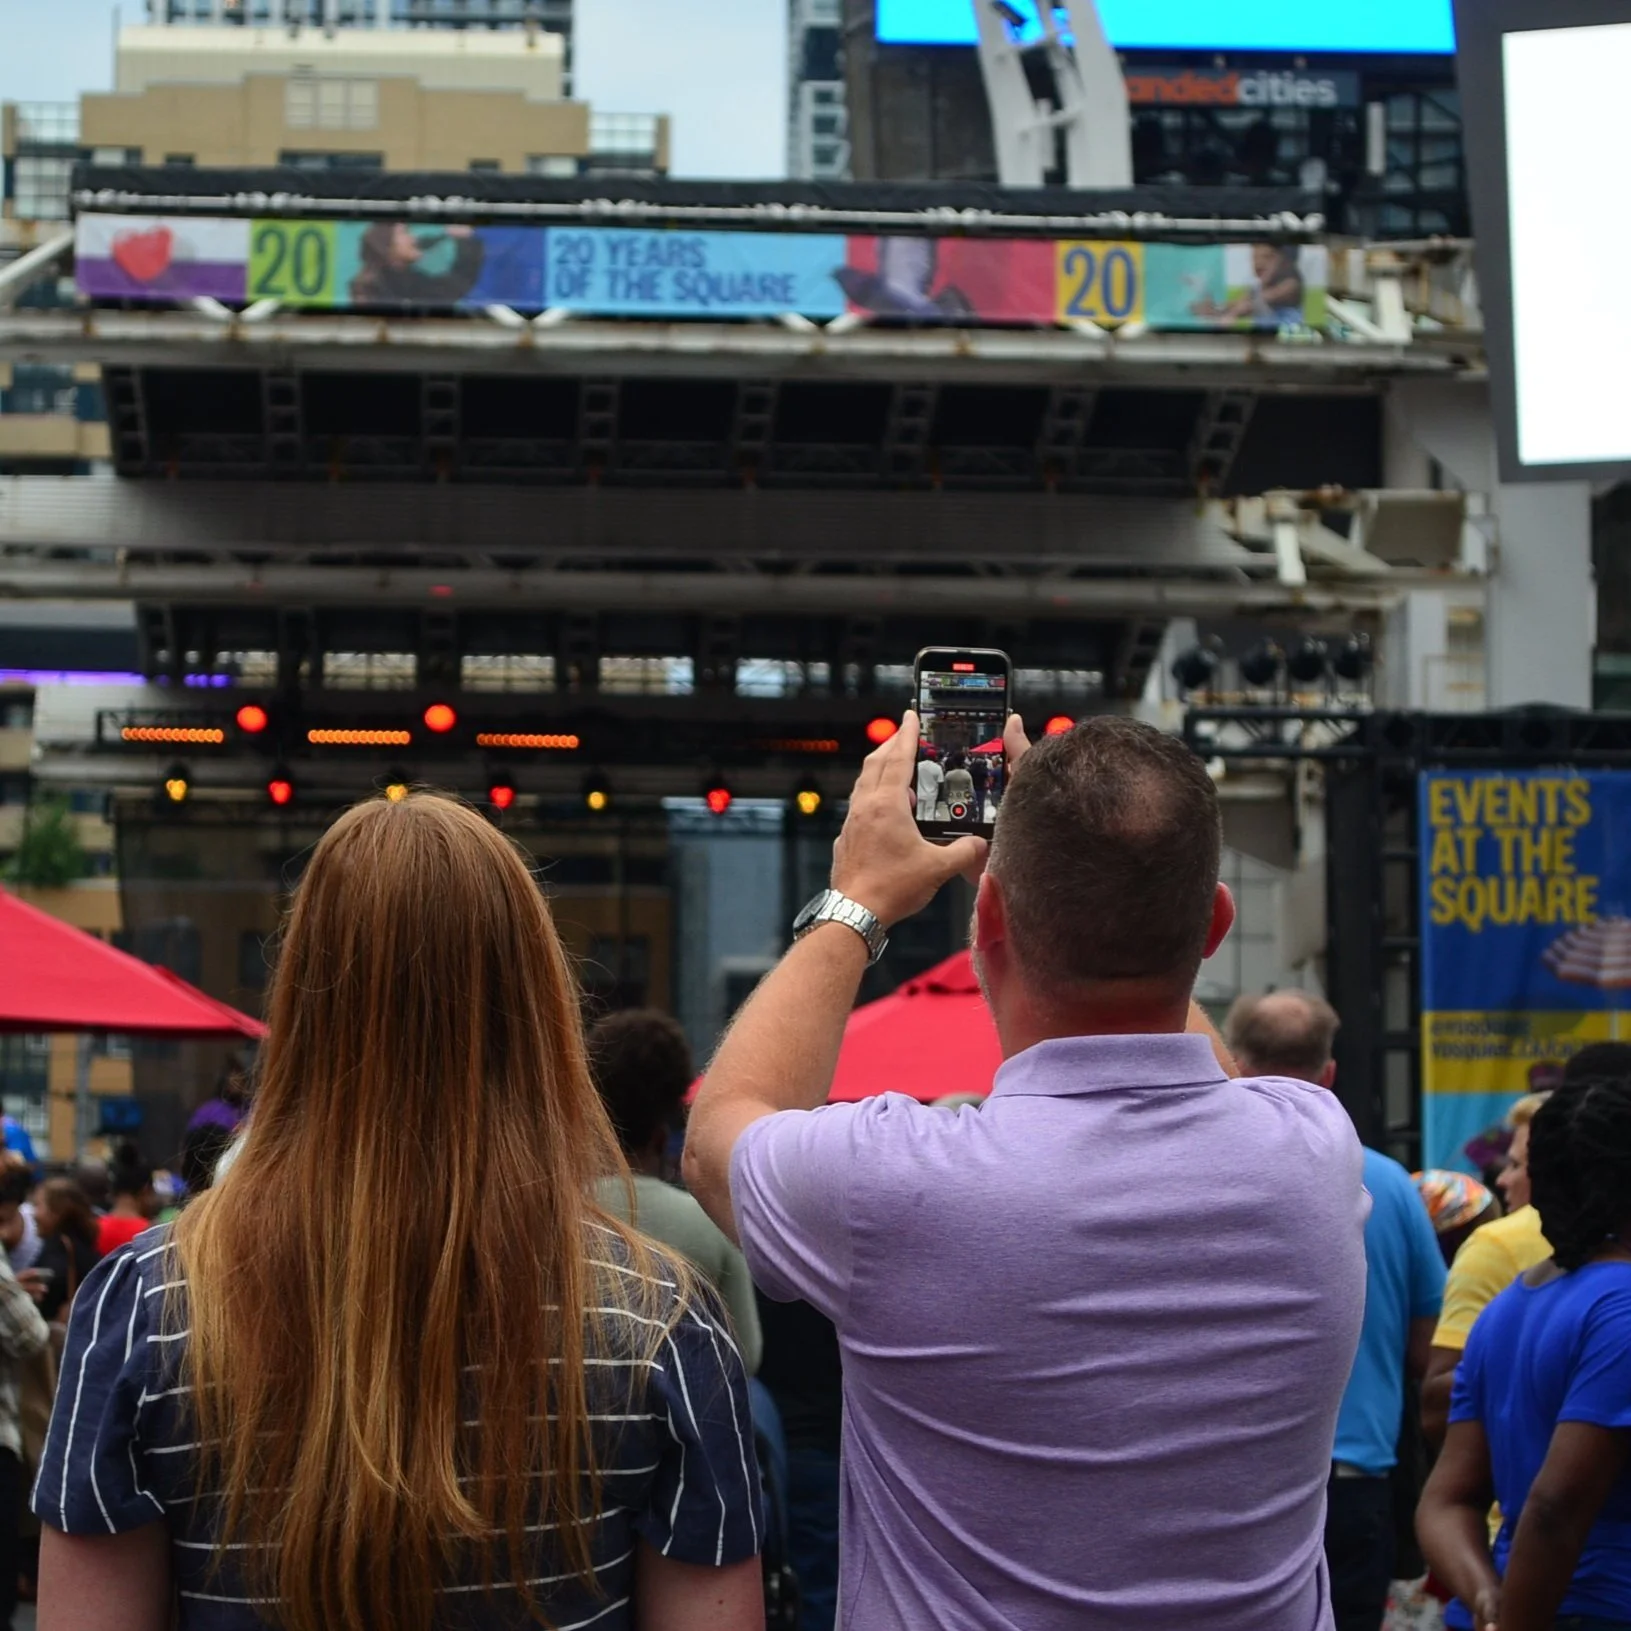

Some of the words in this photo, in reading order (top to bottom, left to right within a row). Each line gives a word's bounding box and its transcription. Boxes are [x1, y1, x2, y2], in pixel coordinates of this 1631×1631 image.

[255, 228, 327, 296] 20
[553, 235, 596, 266] 20
[605, 236, 707, 267] YEARS
[553, 269, 593, 299] OF
[608, 270, 662, 300] THE
[671, 272, 797, 306] SQUARE
[1064, 248, 1135, 317] 20
[1430, 779, 1591, 826] EVENTS
[1431, 827, 1482, 874] AT
[1494, 827, 1576, 874] THE
[1430, 875, 1598, 932] SQUARE
